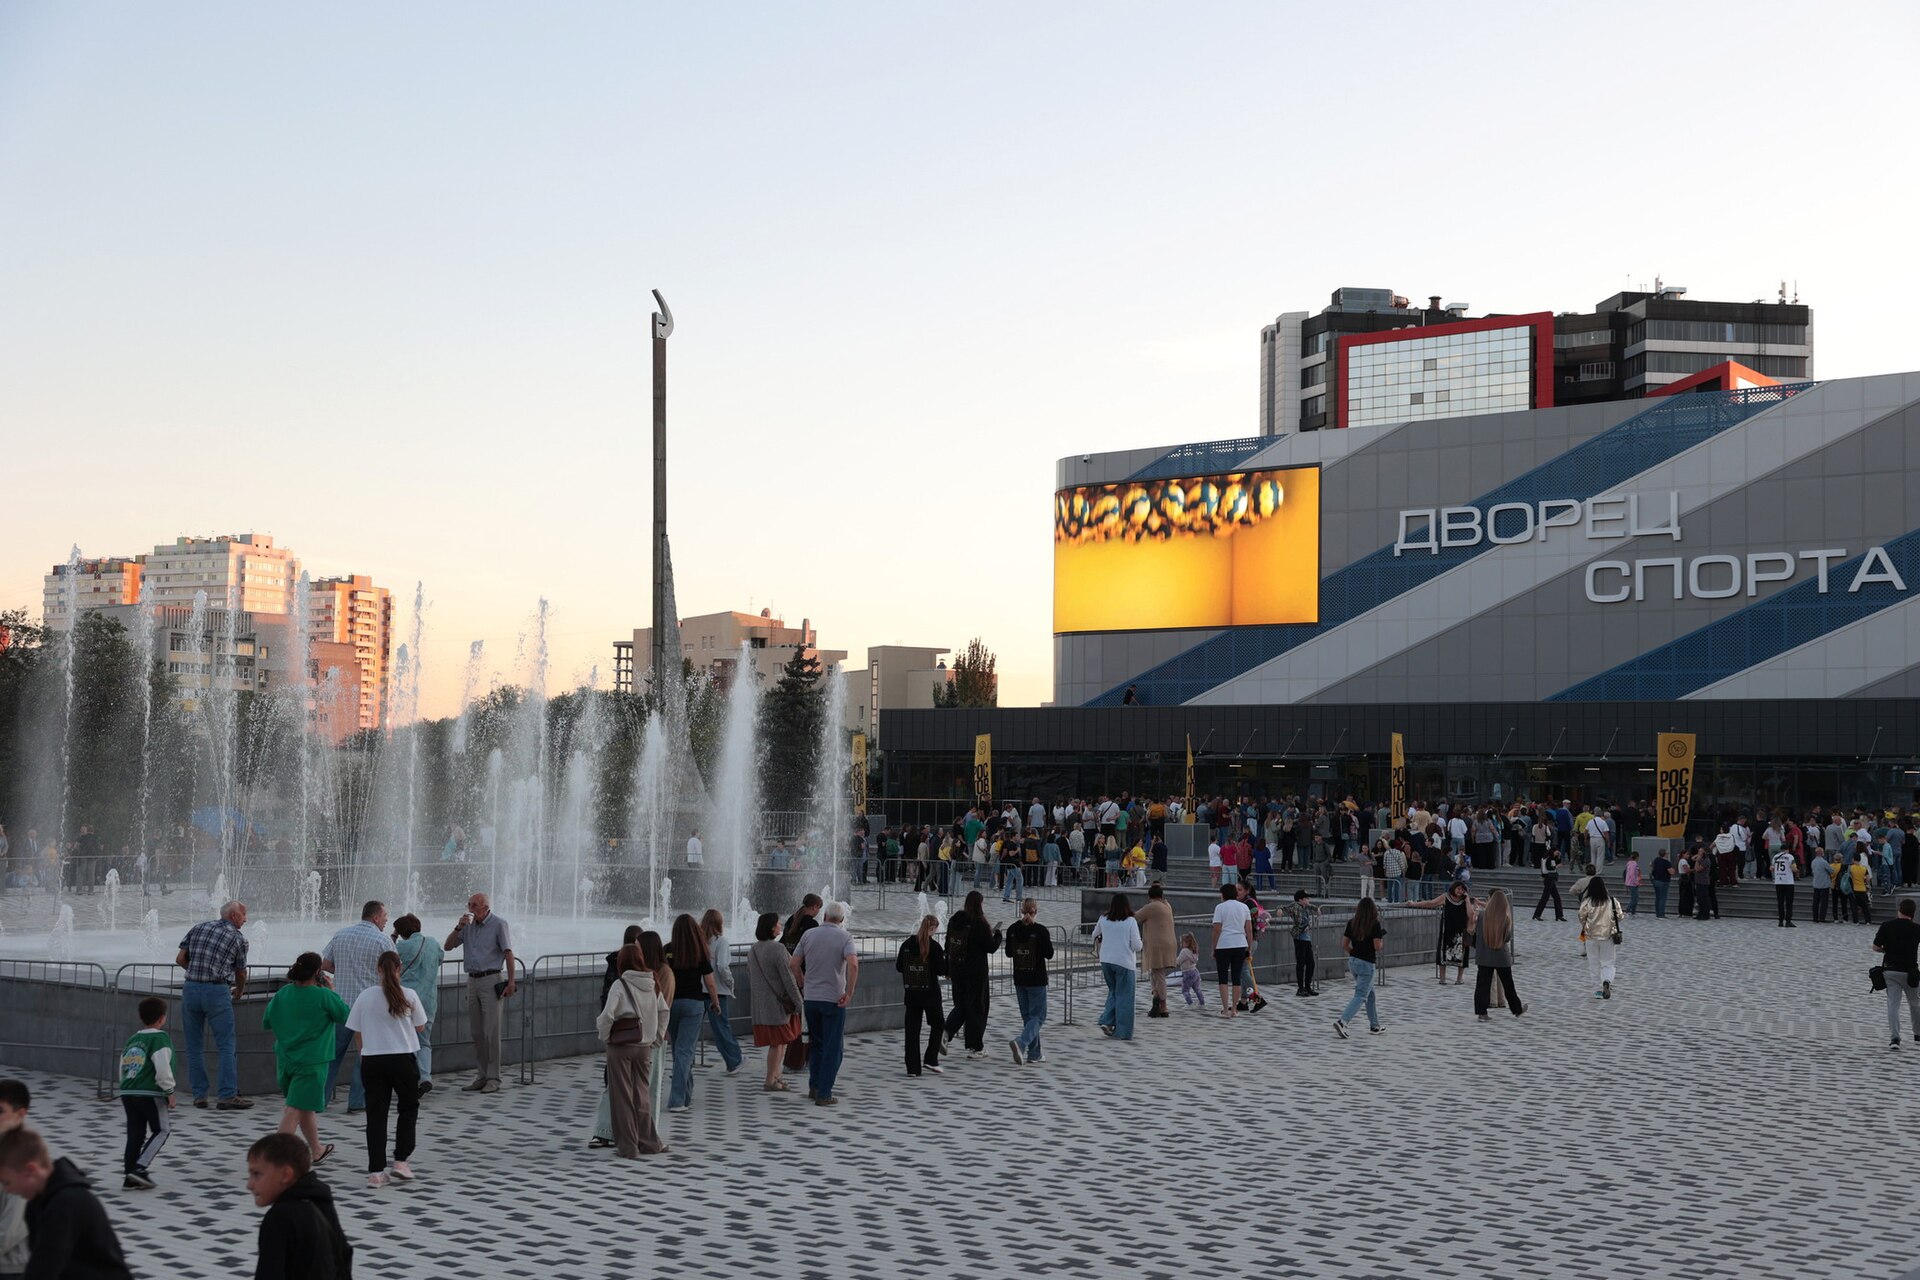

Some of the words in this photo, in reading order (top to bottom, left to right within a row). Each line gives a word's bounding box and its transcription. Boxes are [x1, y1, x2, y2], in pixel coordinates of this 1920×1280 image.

[1393, 491, 1681, 557] ДВОРЕЦ
[1585, 546, 1907, 603] СПОРТА
[1660, 767, 1689, 792] РОС
[1660, 787, 1689, 808] ТОВ
[1774, 861, 1786, 872] 75
